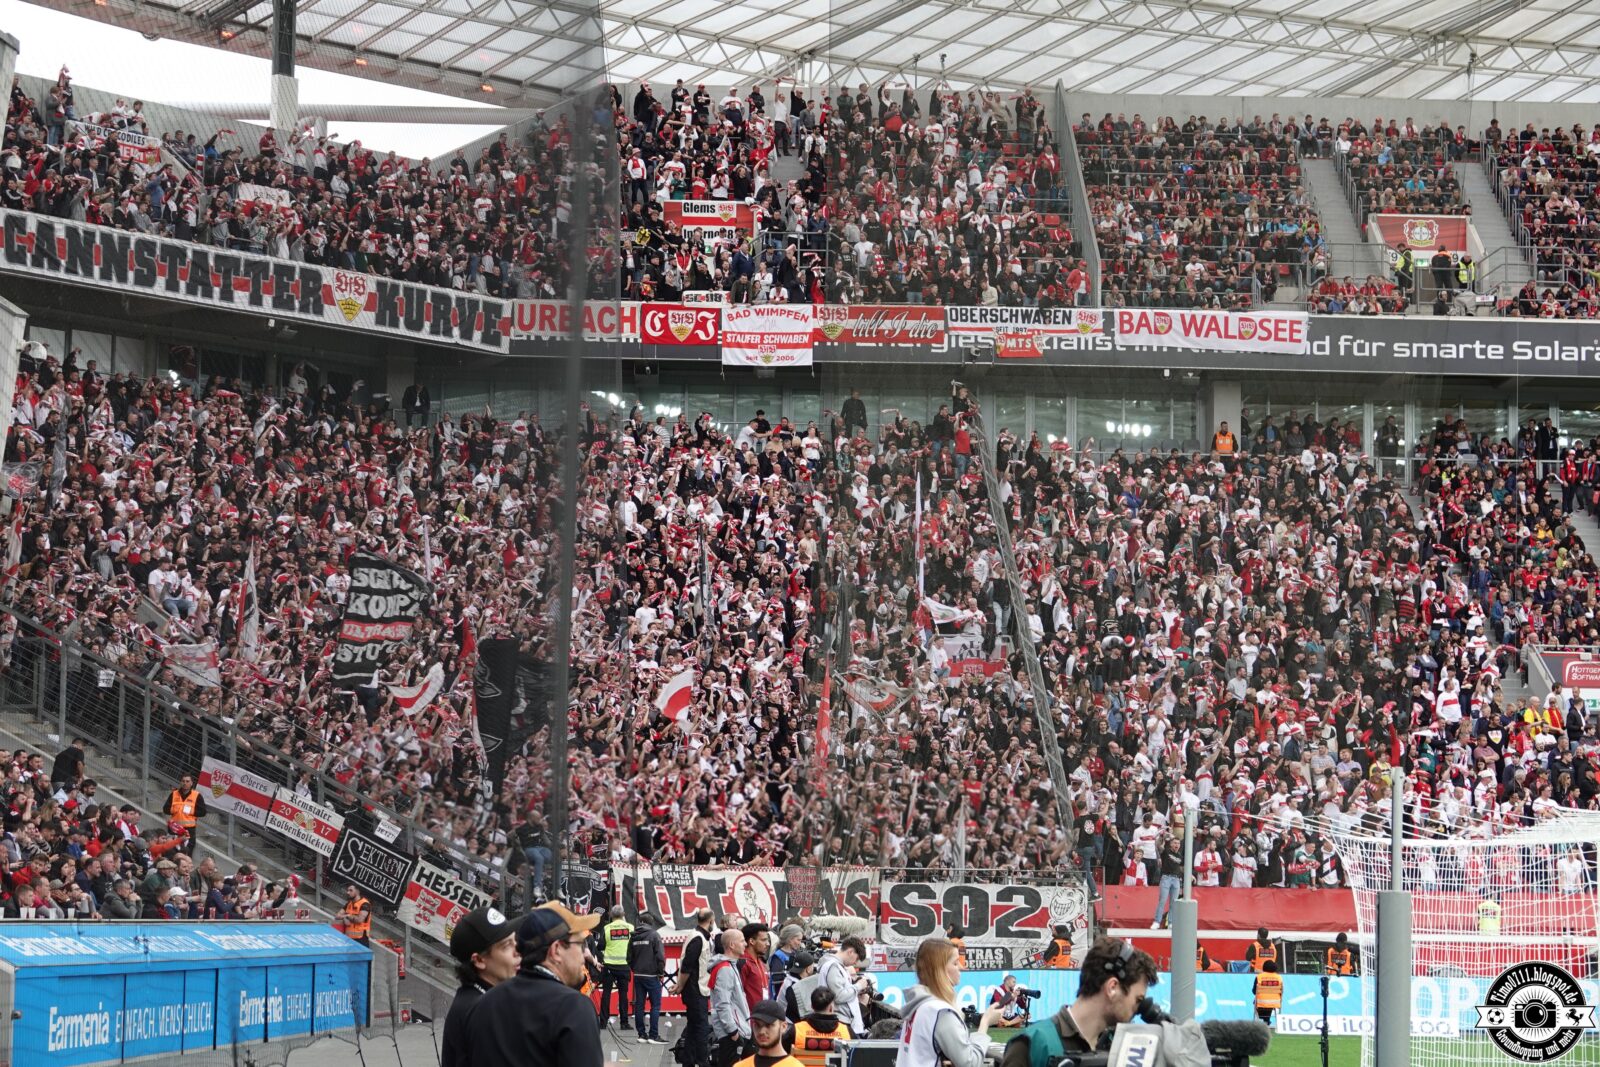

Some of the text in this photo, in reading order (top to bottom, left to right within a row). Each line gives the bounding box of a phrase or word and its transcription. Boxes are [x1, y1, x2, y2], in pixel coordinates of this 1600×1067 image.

[683, 202, 715, 213] Glems
[4, 214, 324, 316] CANNSTATTER
[375, 279, 503, 347] KURVE
[517, 303, 637, 334] URBACH
[727, 307, 809, 323] BAD WIMPFEN
[949, 307, 1072, 326] OBERSCHWABEN
[1118, 310, 1303, 344] BAD WALDSEE
[726, 333, 810, 344] STAUFER SCHWABEN
[1007, 338, 1032, 349] MTS
[1338, 335, 1385, 357] für
[1393, 340, 1504, 360] smarte
[280, 804, 332, 837] 20 17
[663, 871, 691, 879] IMMER
[415, 866, 488, 910] HESSEN
[965, 948, 1004, 960] TRAS
